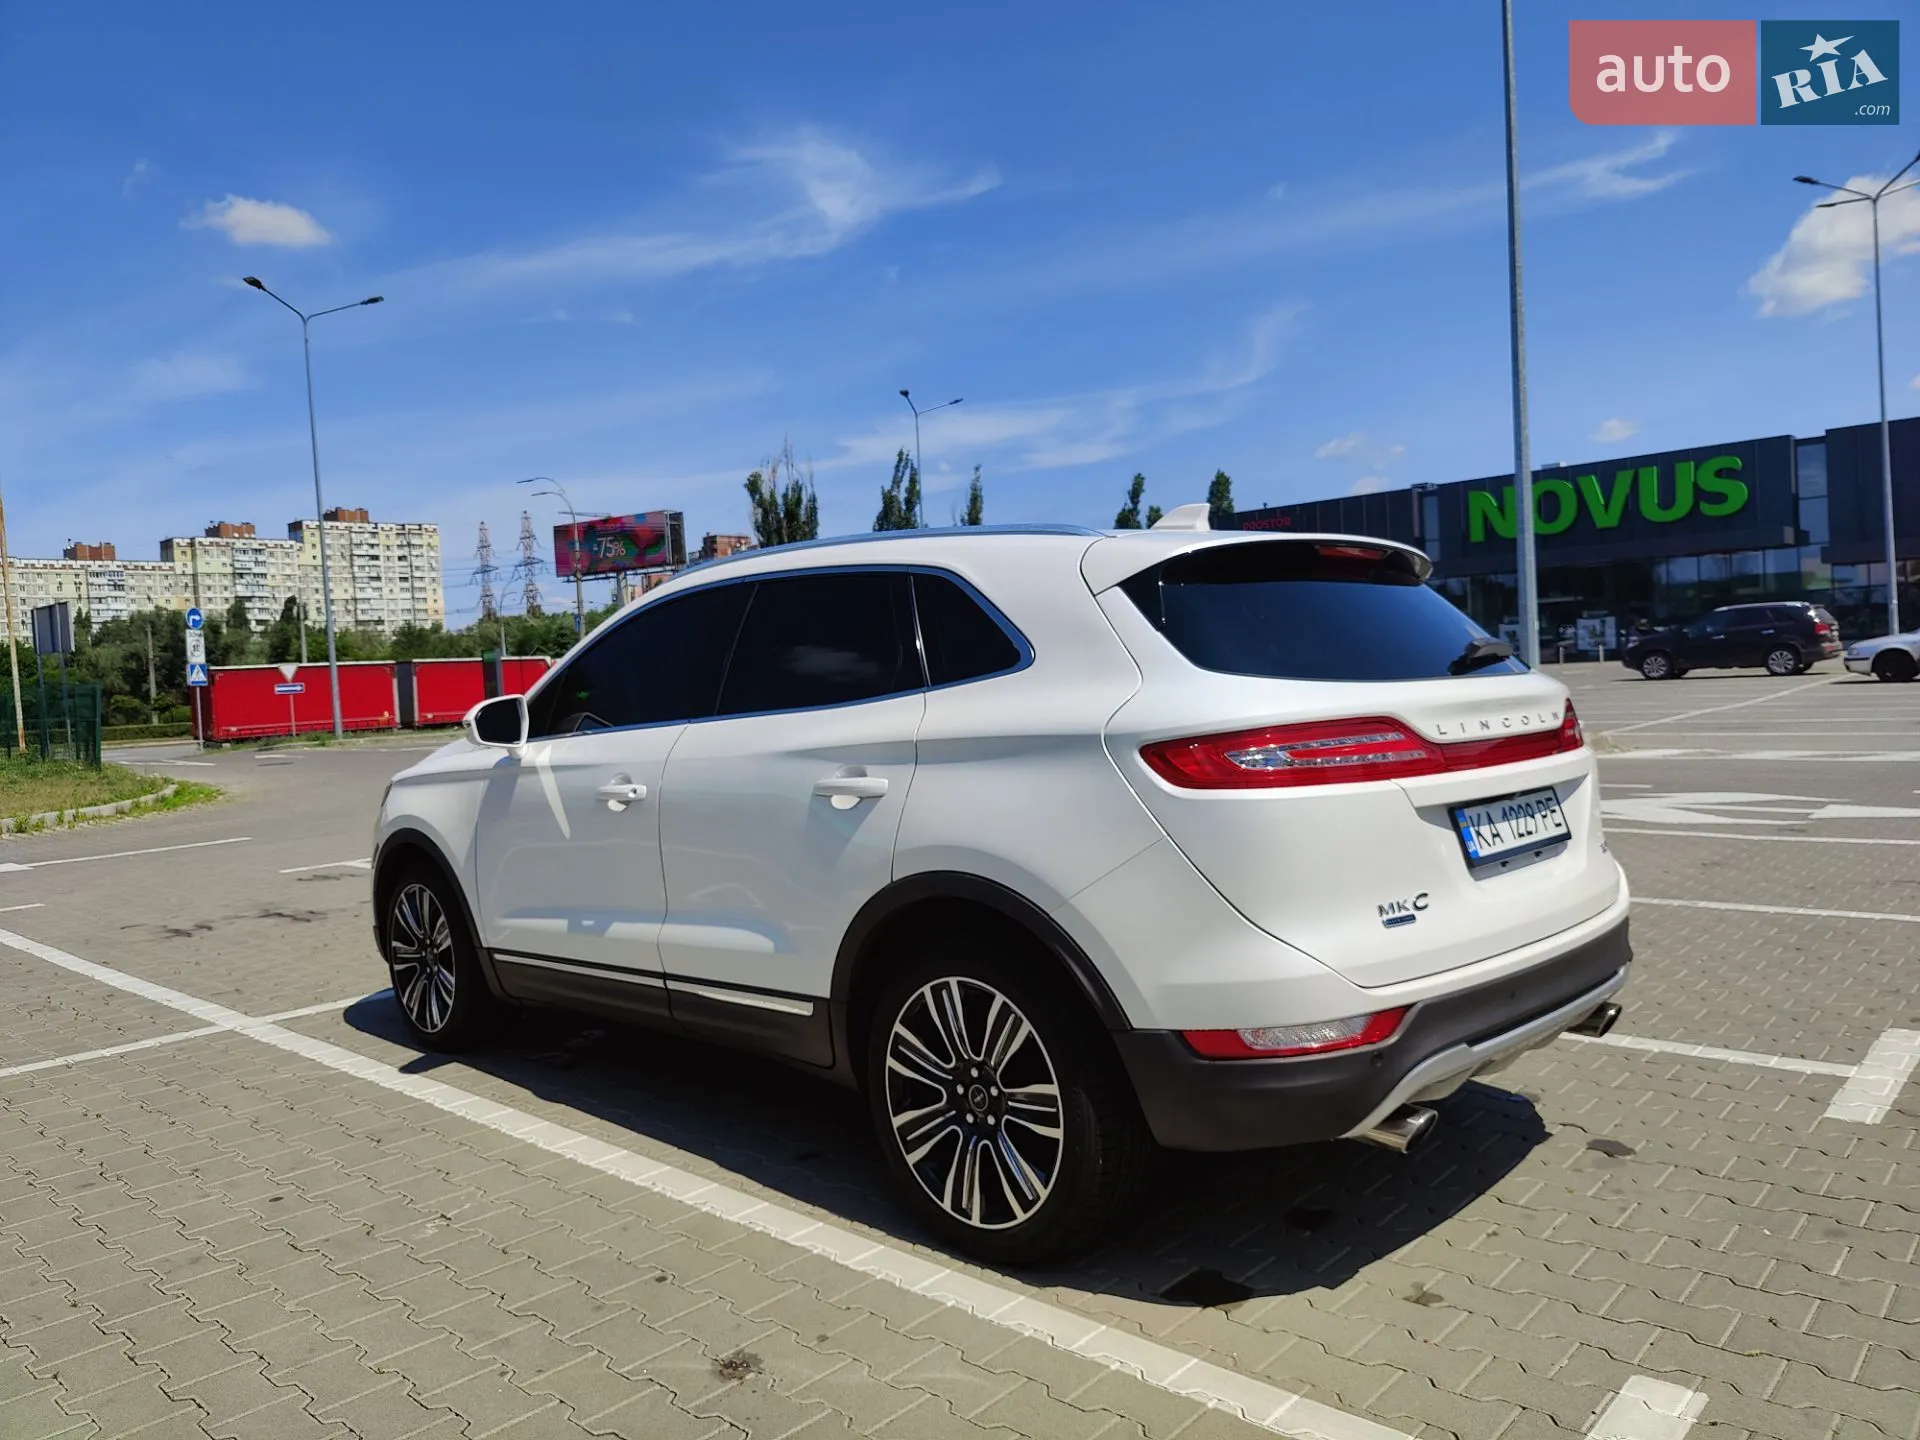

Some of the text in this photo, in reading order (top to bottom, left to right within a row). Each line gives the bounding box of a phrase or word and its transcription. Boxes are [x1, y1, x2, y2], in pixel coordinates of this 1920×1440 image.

[1468, 456, 1749, 543] NOVUS
[1436, 711, 1559, 735] LINCOLN
[1469, 797, 1562, 849] KA 1229 PE
[1377, 892, 1429, 917] MKC
